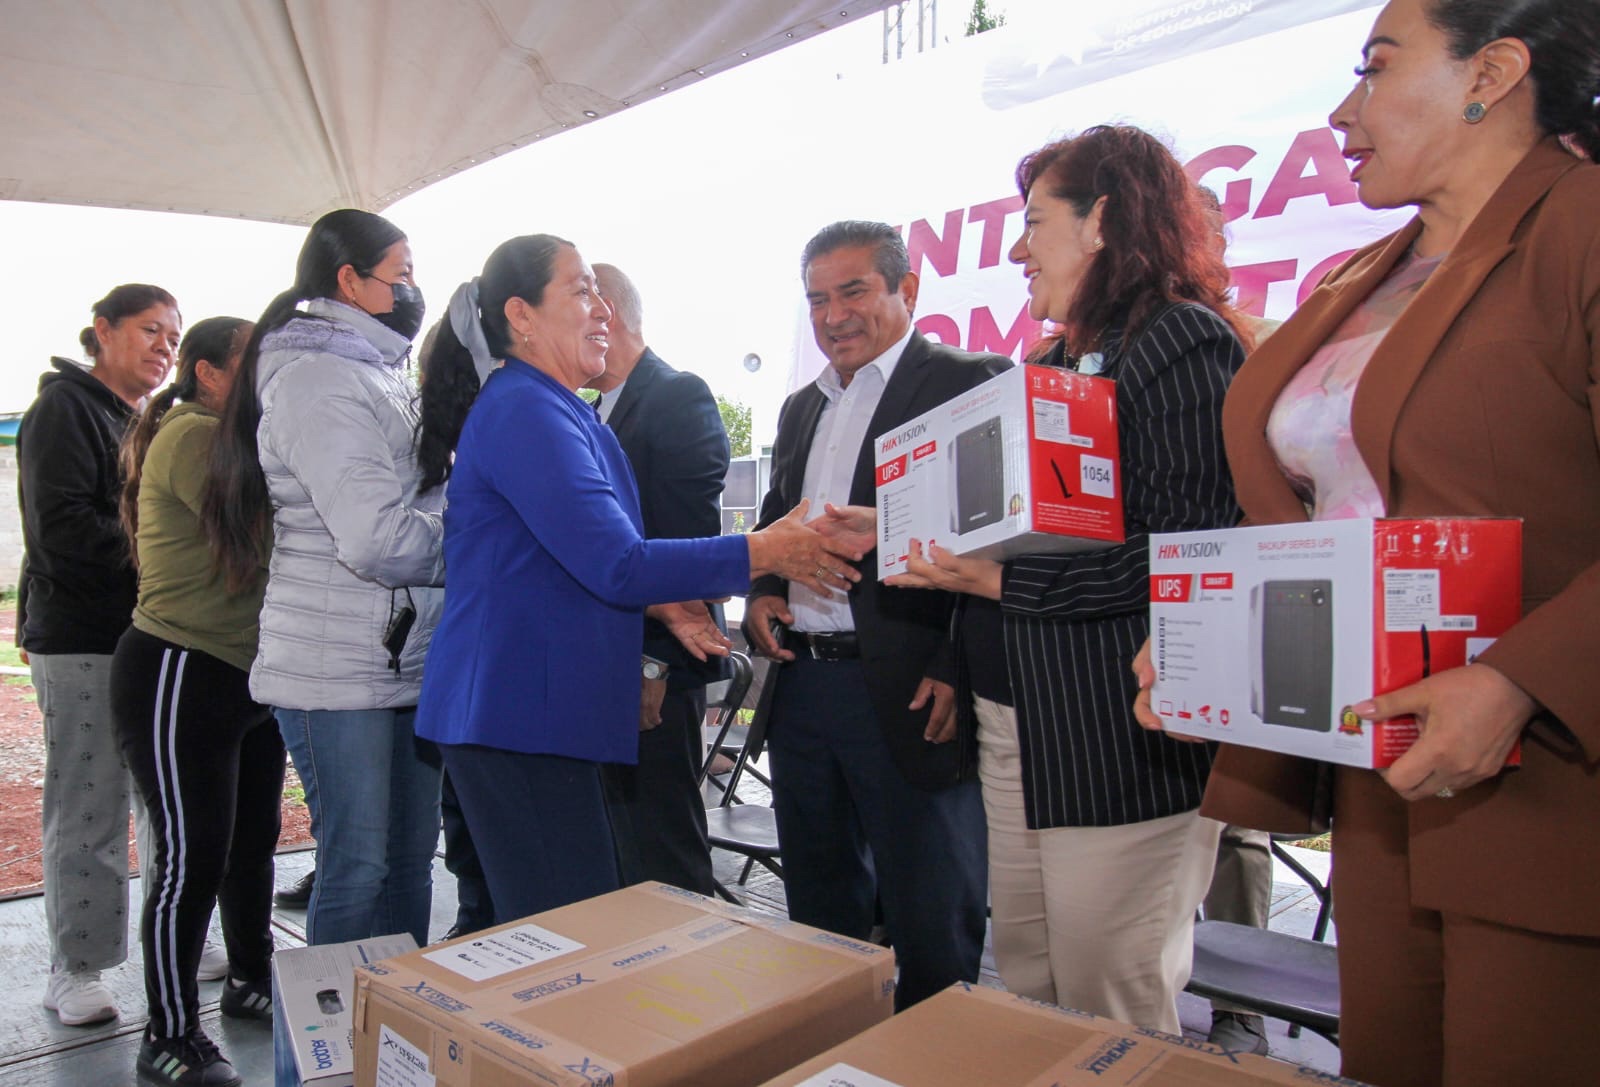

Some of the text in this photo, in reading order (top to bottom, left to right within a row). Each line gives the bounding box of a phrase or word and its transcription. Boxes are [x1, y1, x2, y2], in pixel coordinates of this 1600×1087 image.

[881, 421, 928, 453] HIKVISION
[882, 461, 900, 481] UPS
[1082, 465, 1111, 484] 1054
[1157, 541, 1223, 559] HIKVISION
[1158, 579, 1182, 598] UPS
[1204, 576, 1228, 586] SMART
[480, 1021, 543, 1049] XTREMO
[311, 1039, 333, 1071] brother
